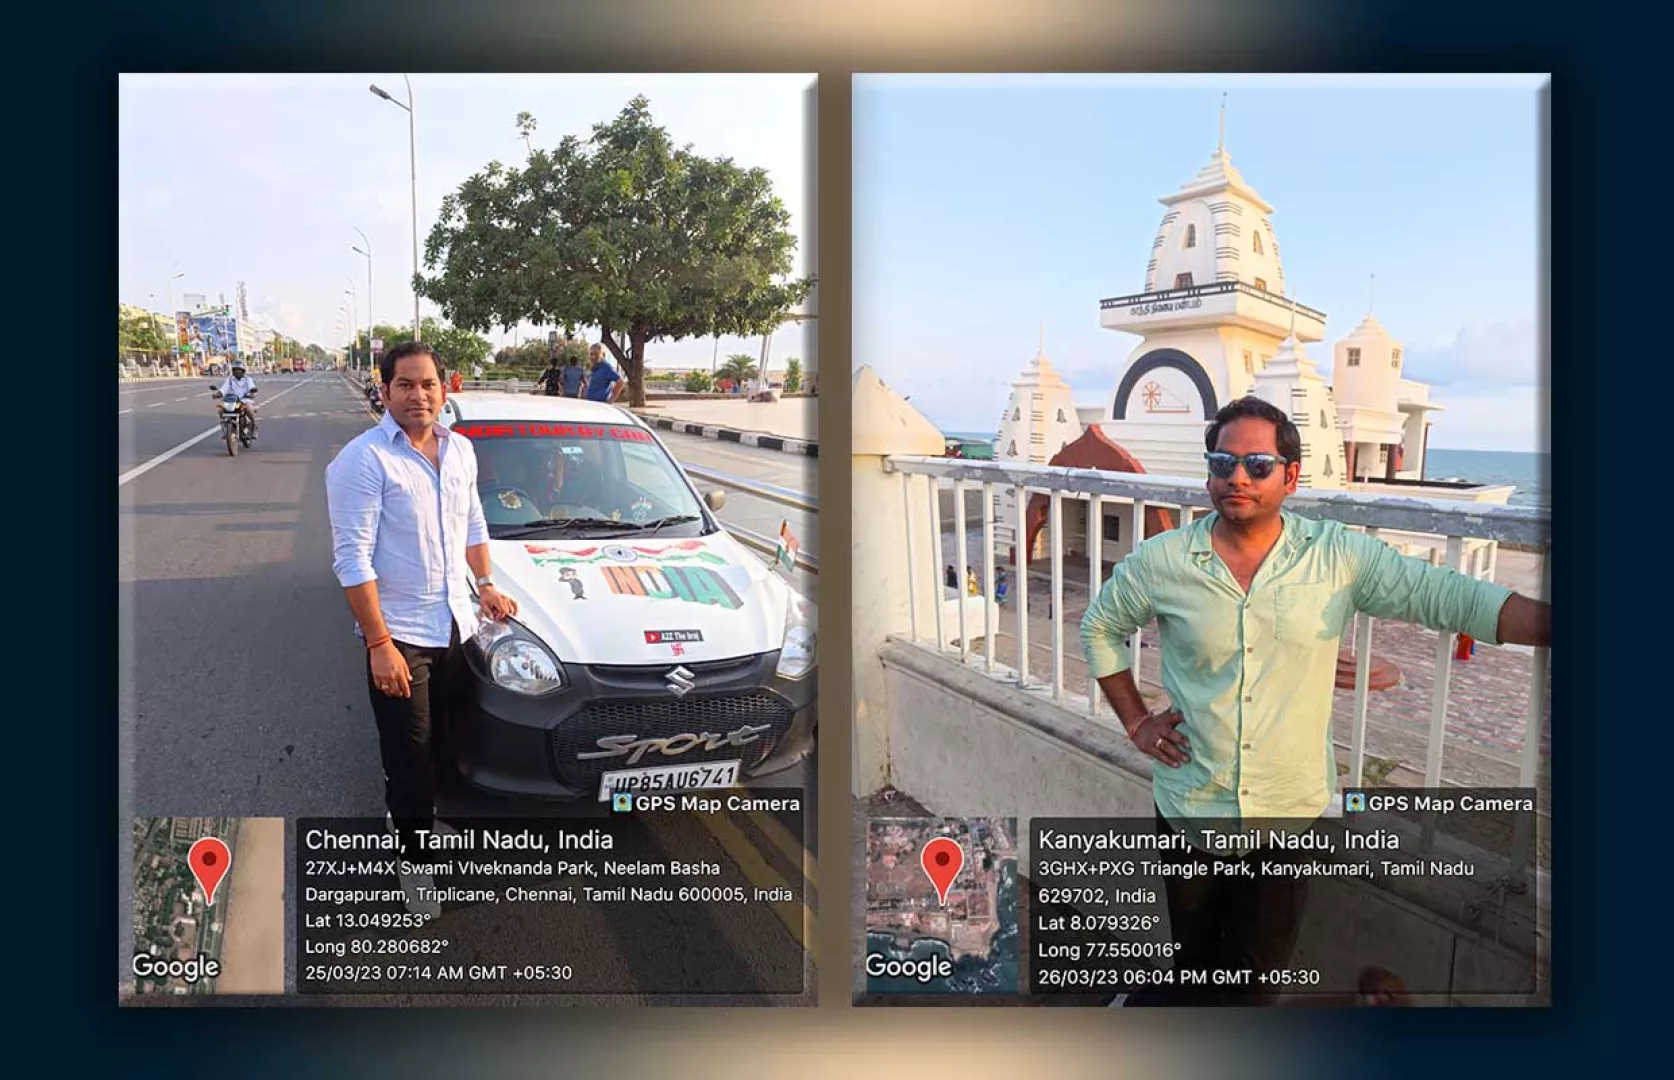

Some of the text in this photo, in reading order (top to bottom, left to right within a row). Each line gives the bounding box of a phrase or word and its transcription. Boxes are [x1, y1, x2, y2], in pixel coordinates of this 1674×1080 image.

[577, 424, 604, 438] BY
[600, 565, 744, 611] INDIA
[614, 766, 735, 794] UP85AU6741
